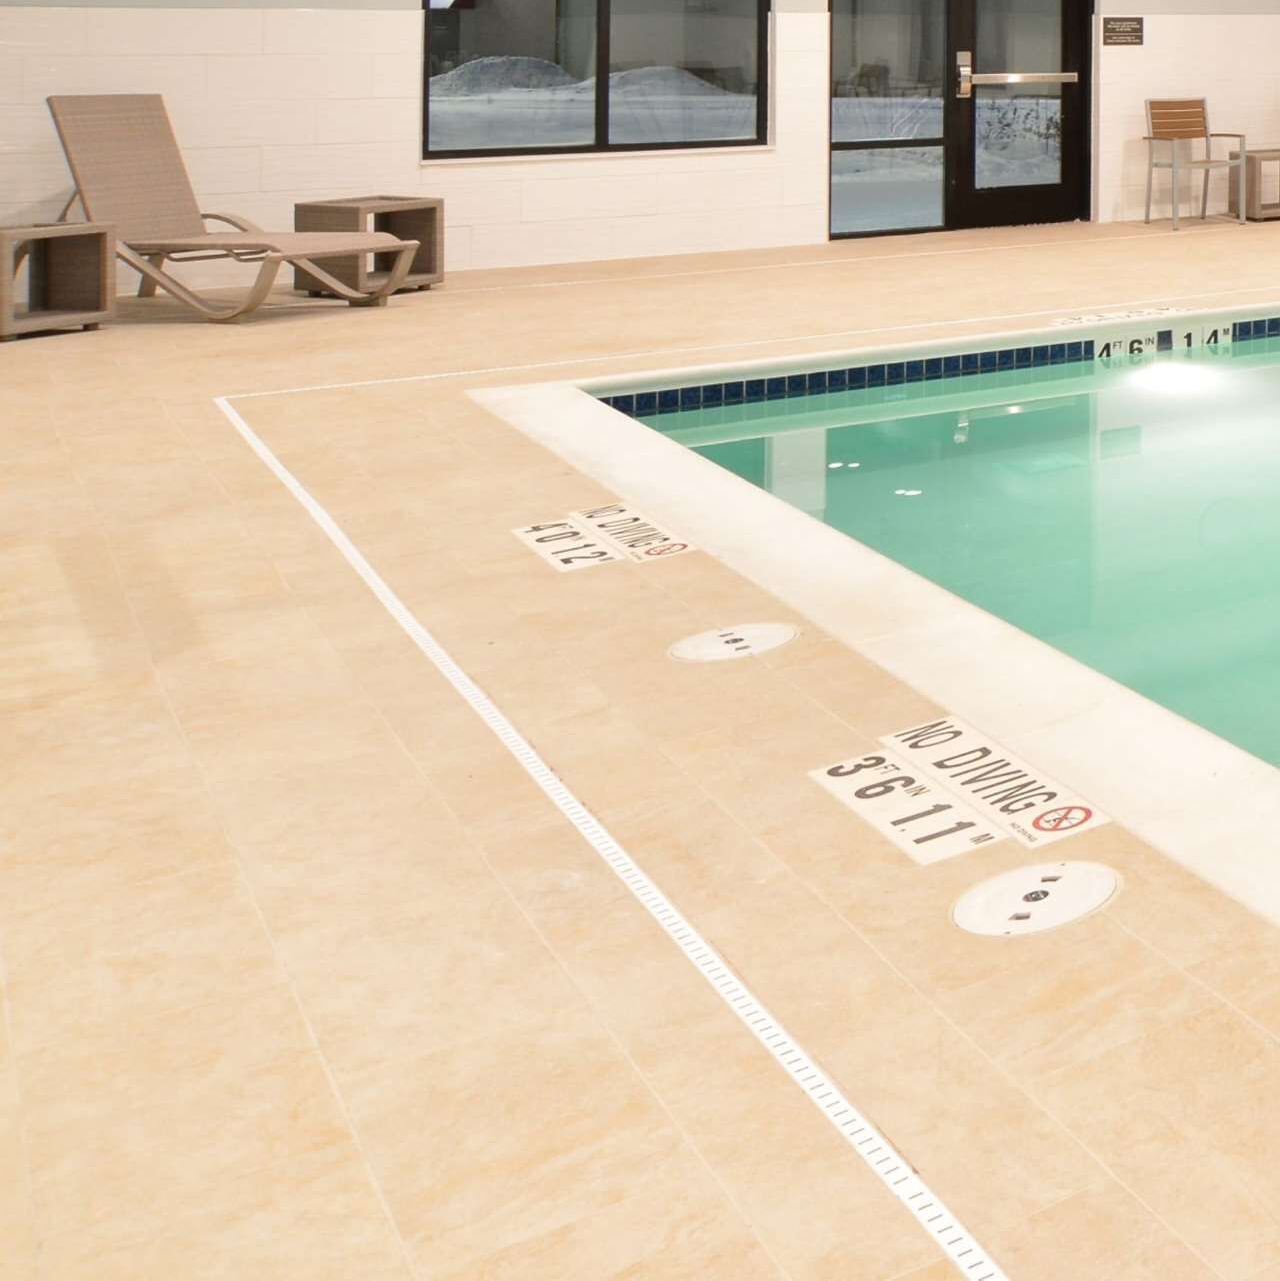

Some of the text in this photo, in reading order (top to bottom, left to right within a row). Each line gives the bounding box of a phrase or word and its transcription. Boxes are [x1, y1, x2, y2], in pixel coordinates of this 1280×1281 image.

[597, 517, 671, 549] DIVING
[893, 720, 1058, 816] NO DIVING
